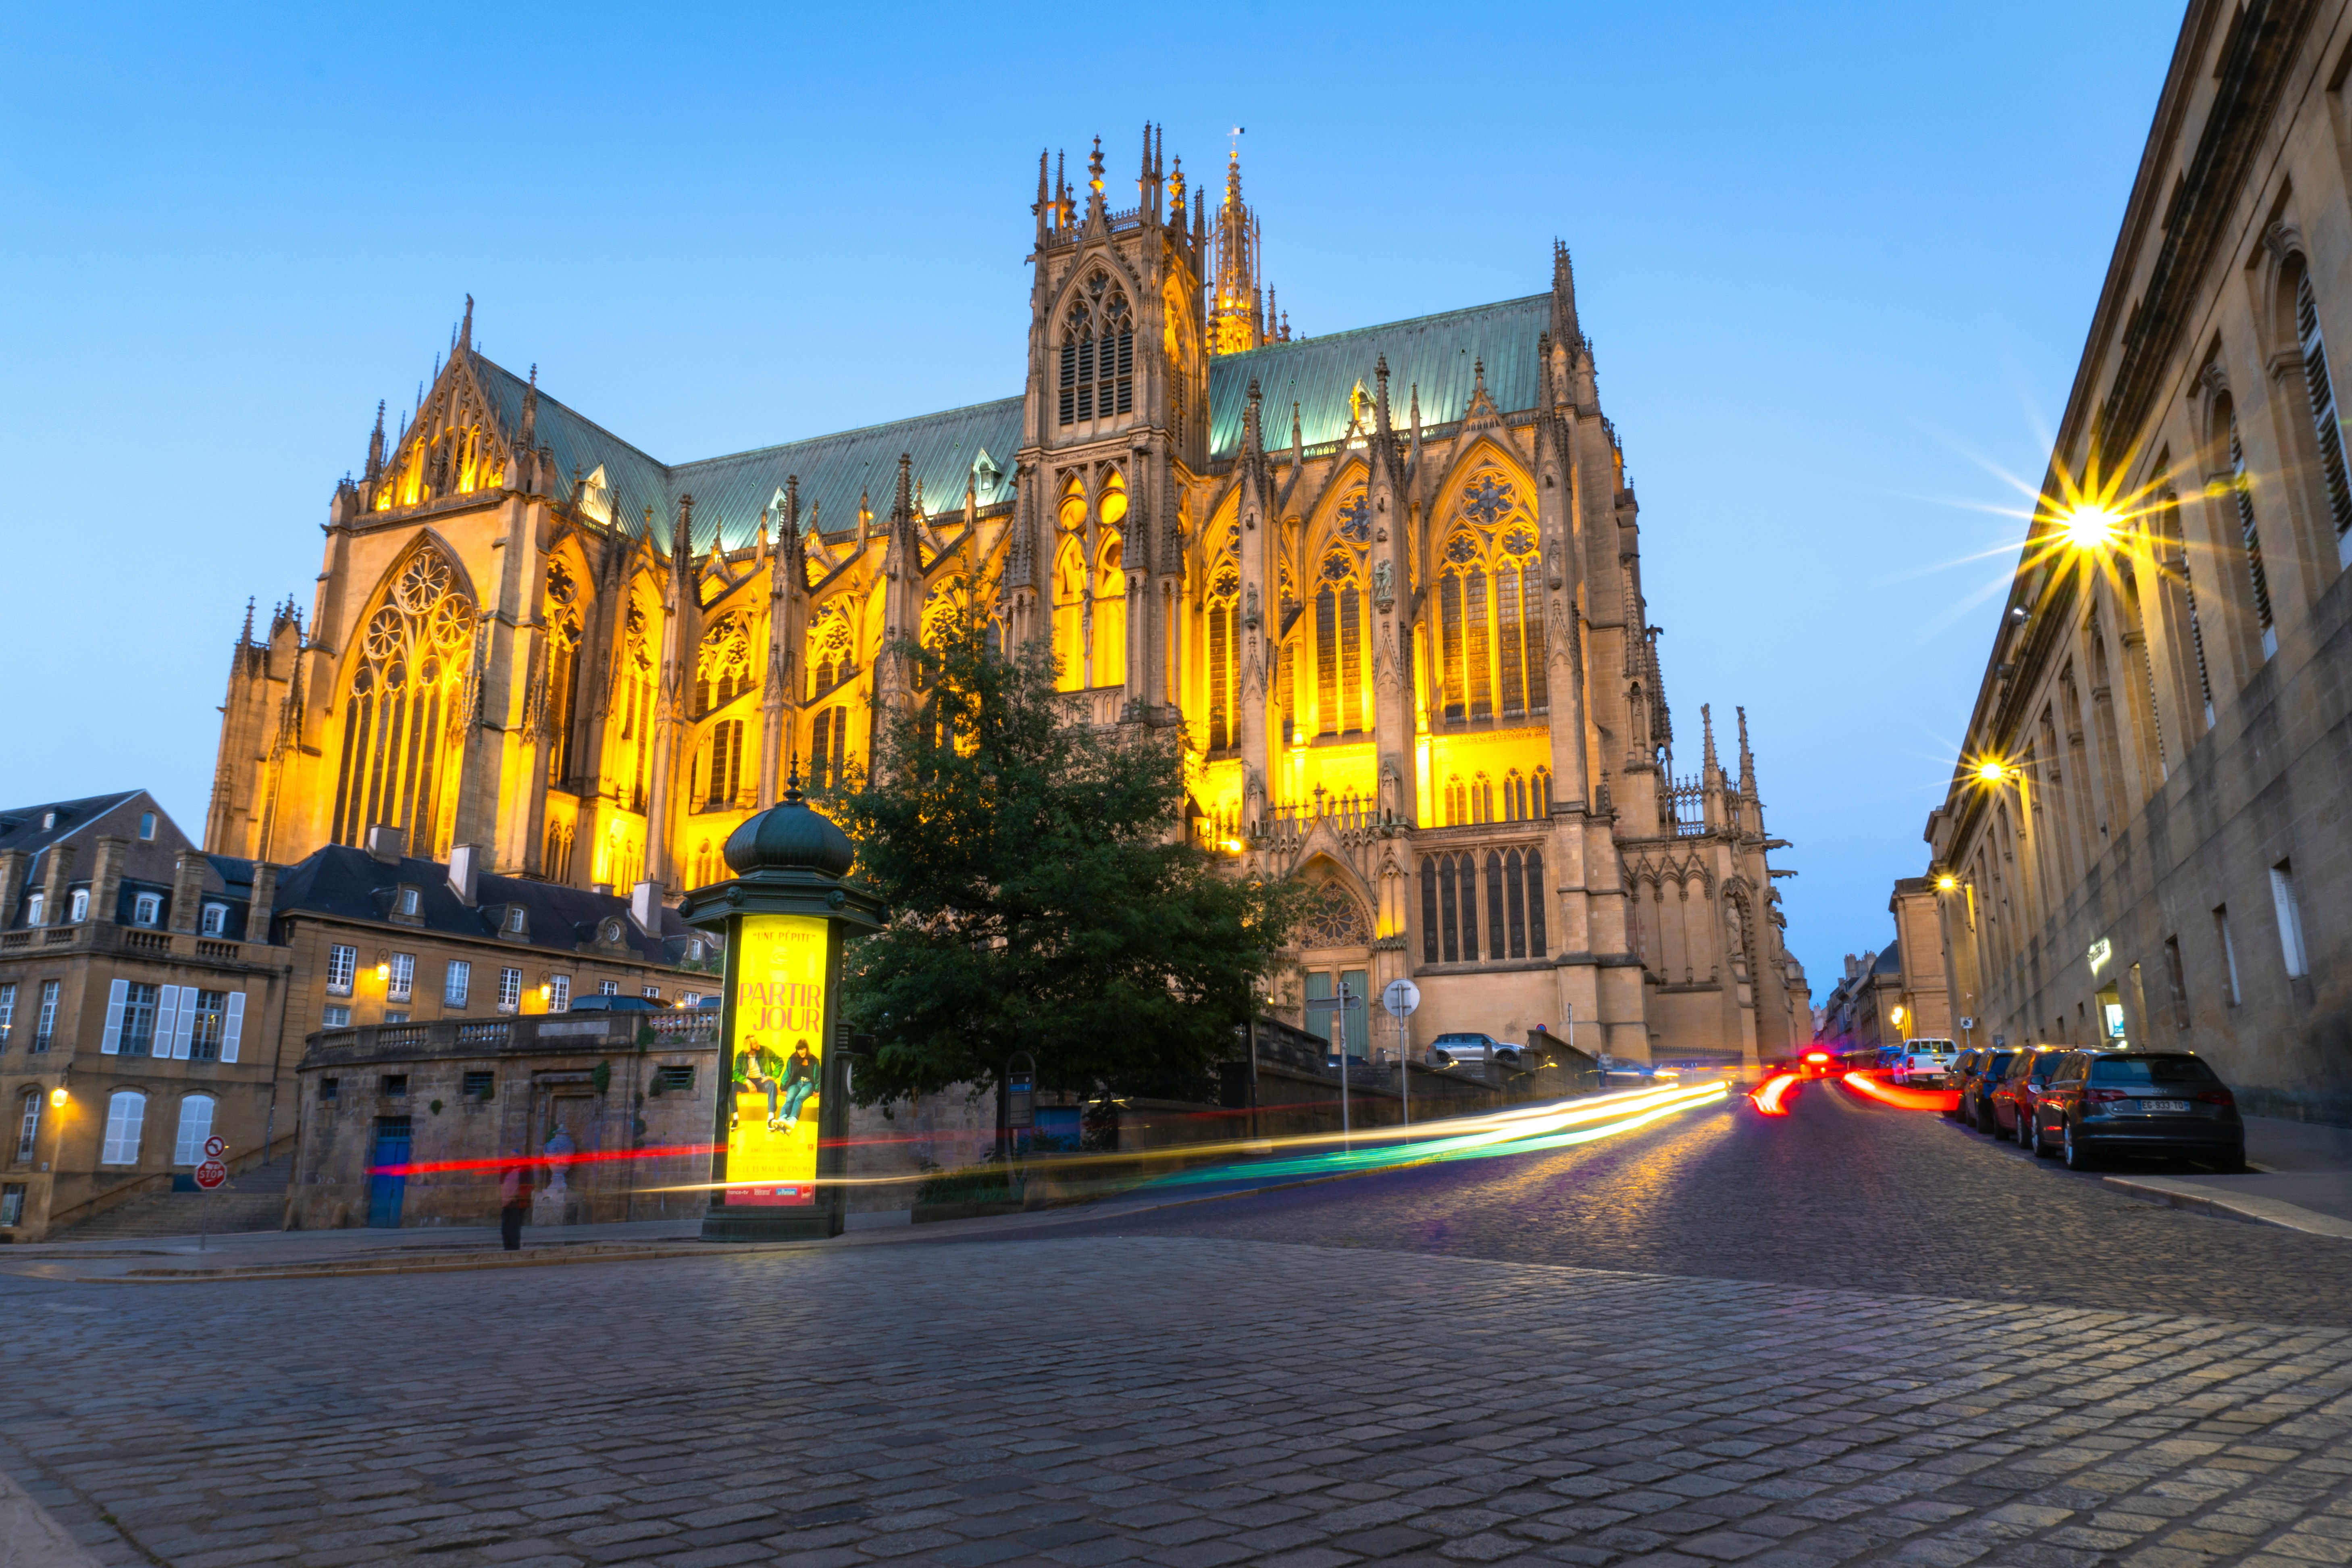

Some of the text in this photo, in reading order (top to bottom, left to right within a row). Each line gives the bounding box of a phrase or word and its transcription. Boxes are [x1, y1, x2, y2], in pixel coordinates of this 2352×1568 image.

[739, 982, 821, 1008] PARTIR
[745, 1007, 757, 1016] UN
[753, 1007, 820, 1033] JOUR
[199, 1170, 223, 1179] STOP
